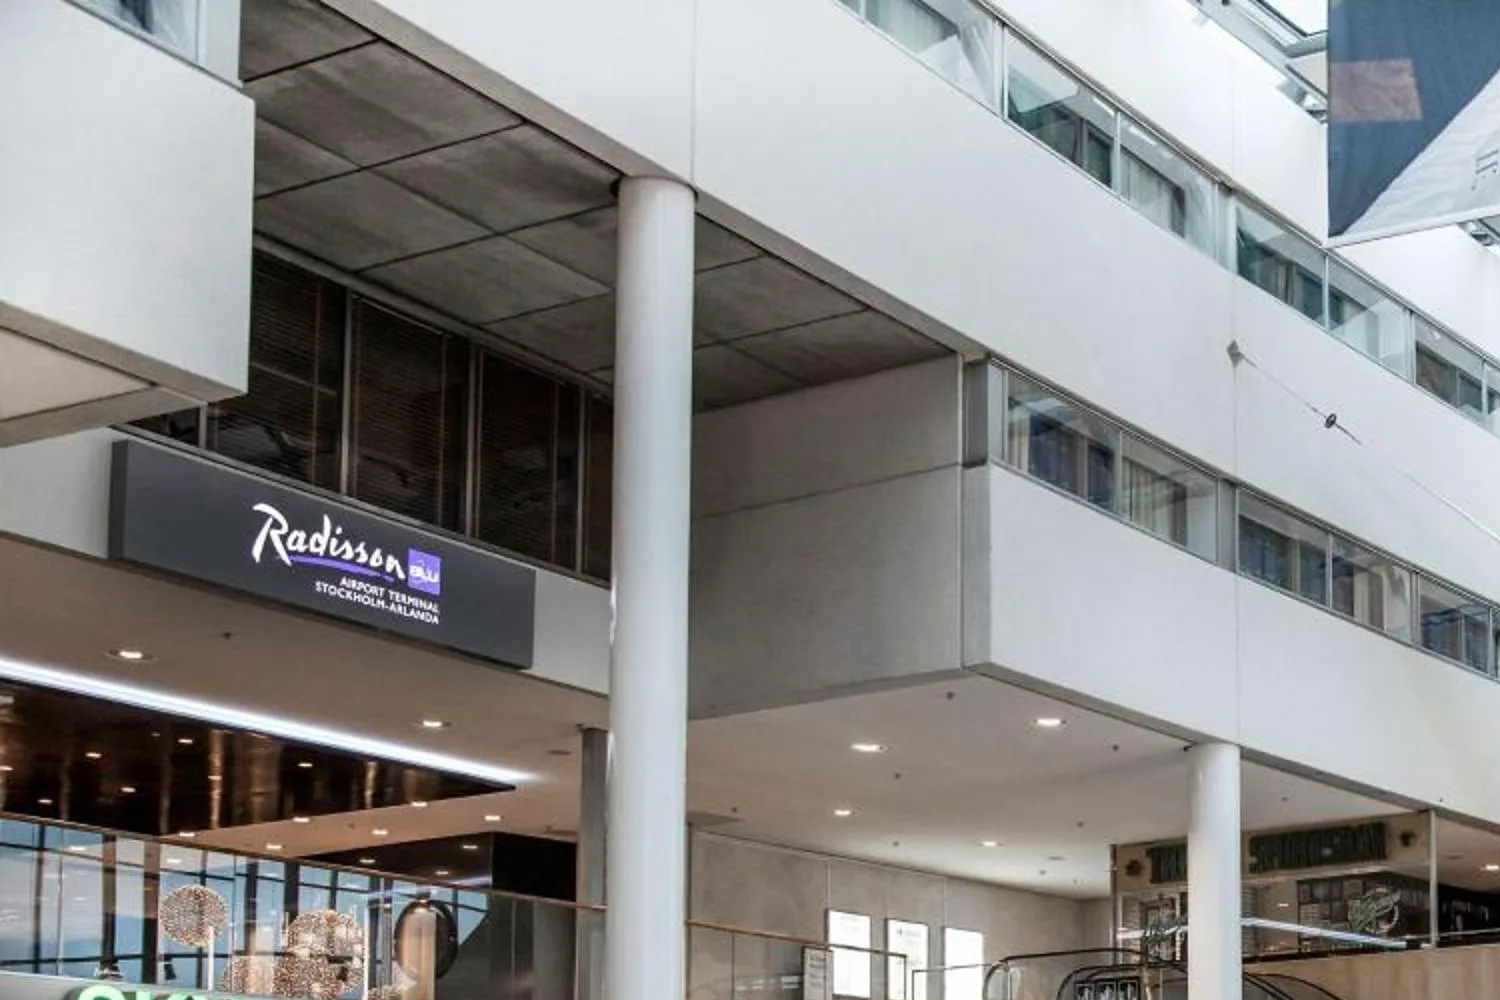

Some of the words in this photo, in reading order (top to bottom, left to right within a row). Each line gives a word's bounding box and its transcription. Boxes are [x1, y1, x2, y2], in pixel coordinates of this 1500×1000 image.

[252, 503, 406, 579] Radisson
[315, 581, 439, 625] STOCKHOLM-ARLANDA
[340, 576, 385, 598] AIRPORT
[388, 589, 439, 613] TERMINAL
